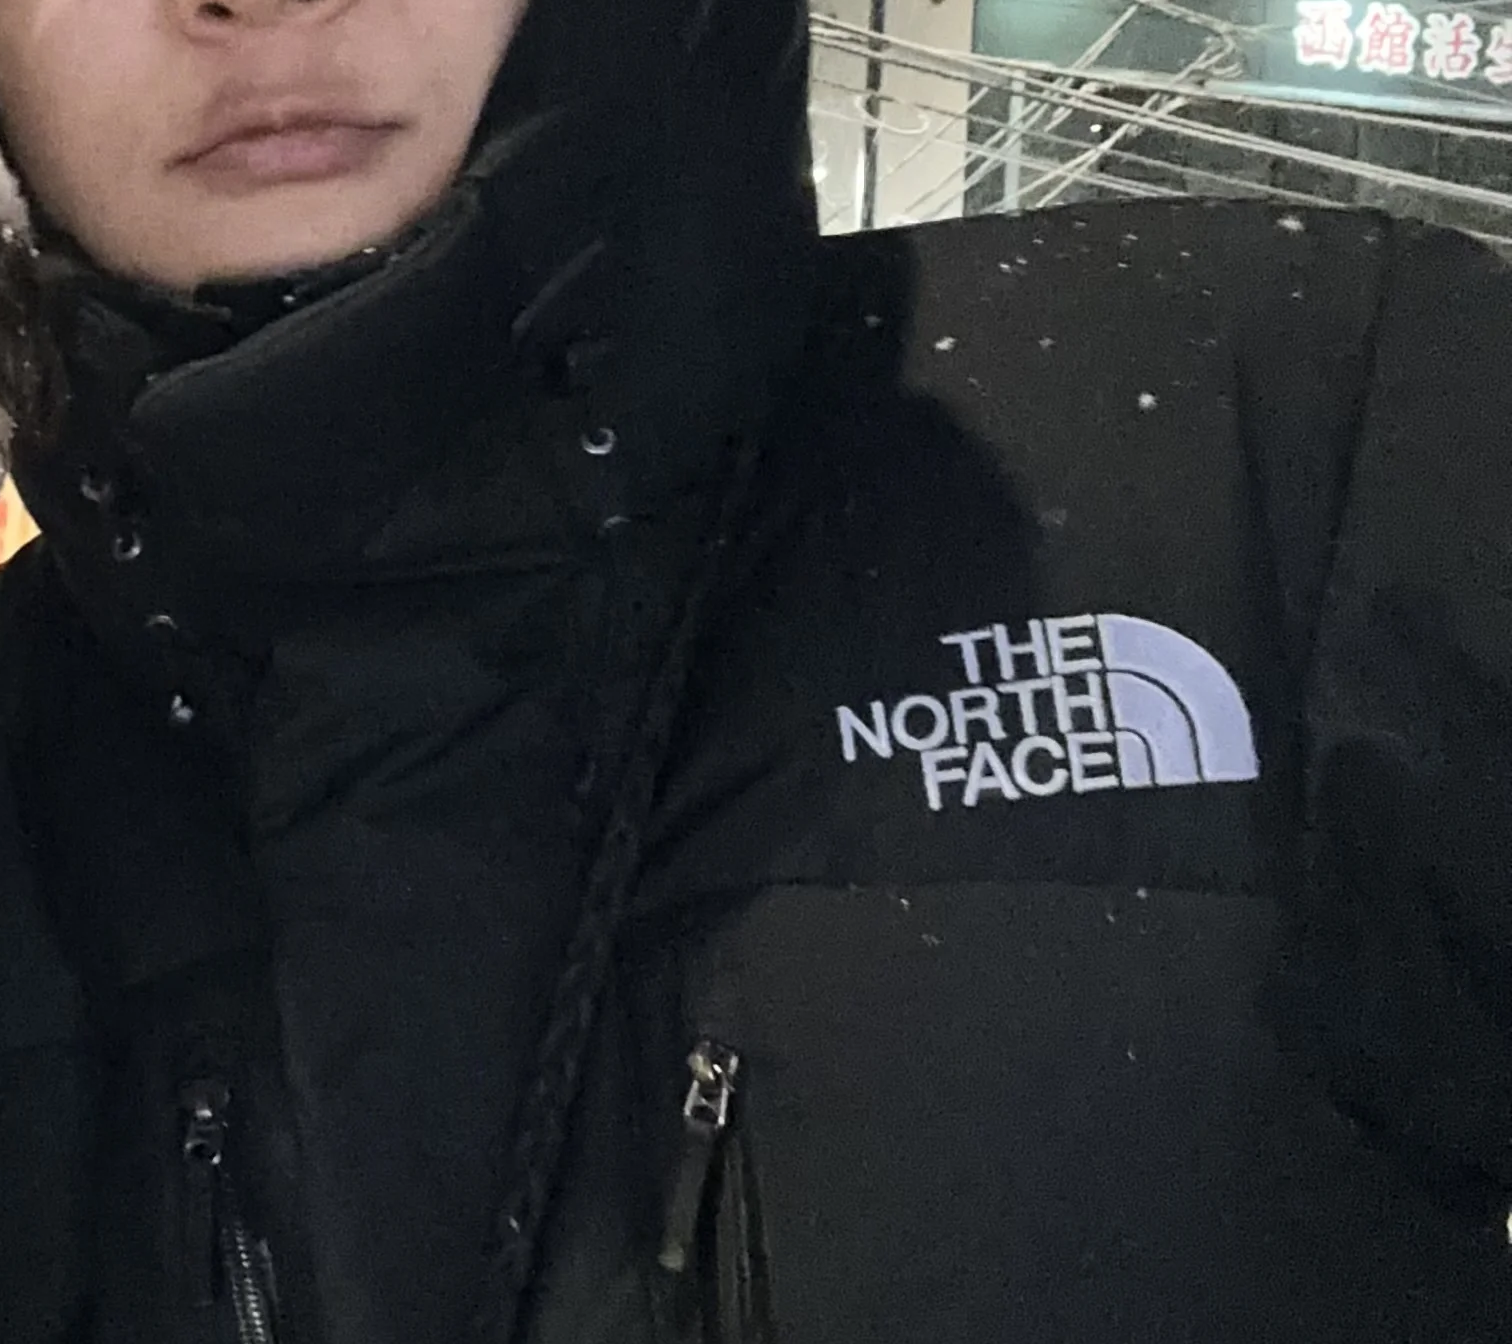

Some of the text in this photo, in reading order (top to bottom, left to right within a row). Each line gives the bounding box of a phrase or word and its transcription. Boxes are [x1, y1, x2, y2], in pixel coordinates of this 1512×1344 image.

[940, 613, 1103, 684] THE
[836, 671, 1108, 763] NORTH
[920, 731, 1120, 812] FACE
